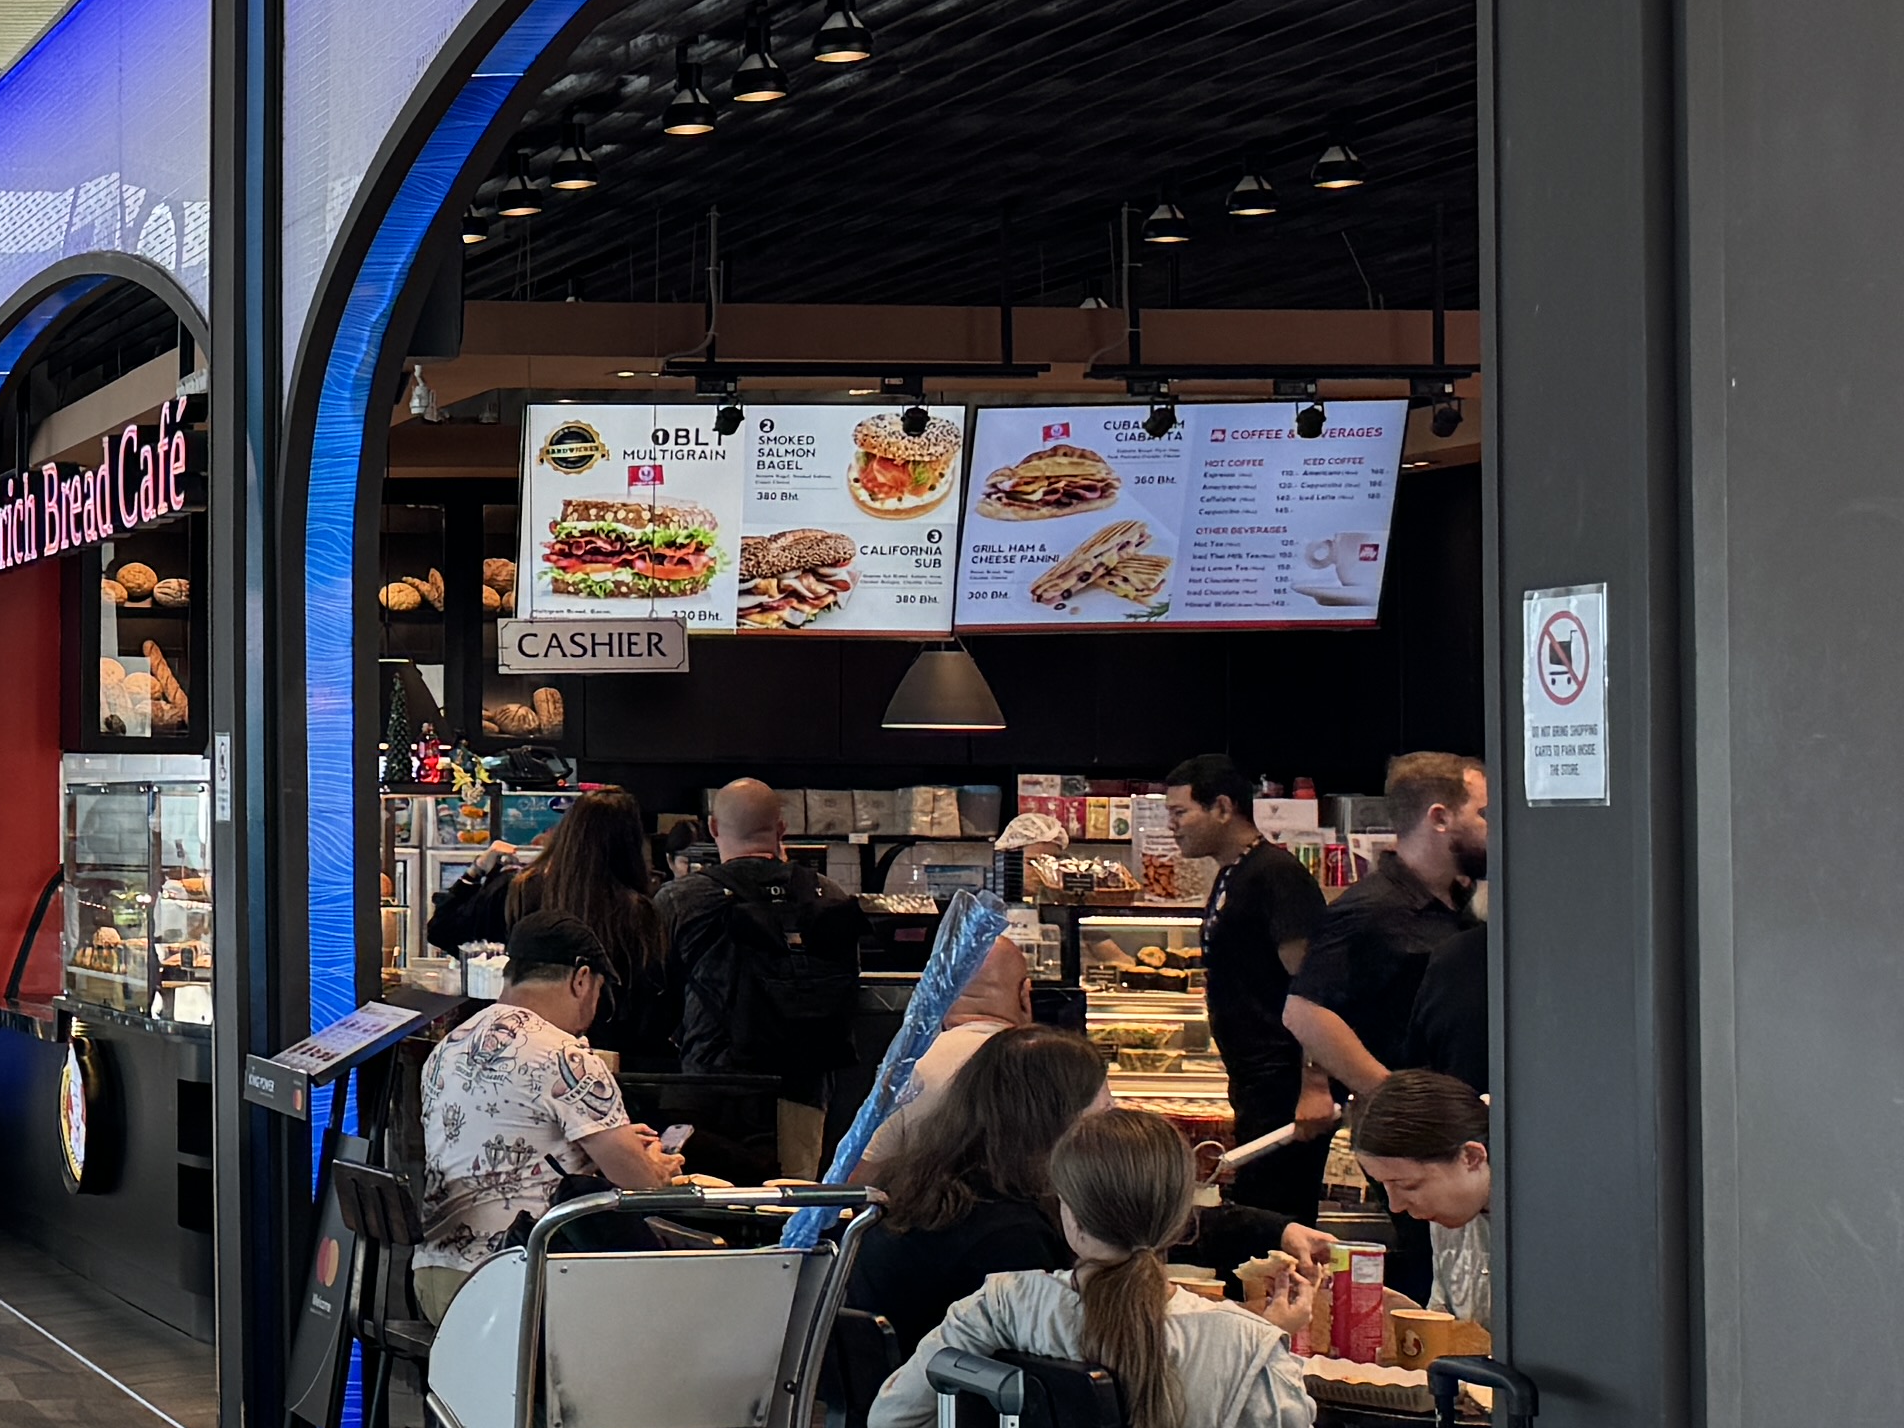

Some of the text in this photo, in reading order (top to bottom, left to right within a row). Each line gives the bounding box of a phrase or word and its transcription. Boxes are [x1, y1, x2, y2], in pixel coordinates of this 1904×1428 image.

[1103, 420, 1144, 431] CUBA
[1231, 429, 1283, 440] COFFEE
[1287, 429, 1296, 439] &
[1322, 427, 1383, 438] VERAGES
[758, 435, 815, 445] SMOKED
[623, 449, 726, 461] MULTIGRAIN
[757, 448, 816, 458] SALMON
[756, 460, 803, 470] BAGEL
[1205, 458, 1264, 467] HOT COFFEE
[1328, 457, 1365, 465] COFFEE
[43, 436, 113, 556] Bread
[118, 395, 187, 528] Café
[1195, 526, 1288, 535] OTHER BEVERAGES
[860, 545, 943, 556] CALIFORNIA
[972, 543, 1046, 553] GRILL HAM &
[914, 558, 942, 569] SUB
[971, 554, 1060, 564] CHEESE PANINI
[517, 632, 667, 658] CASHIER
